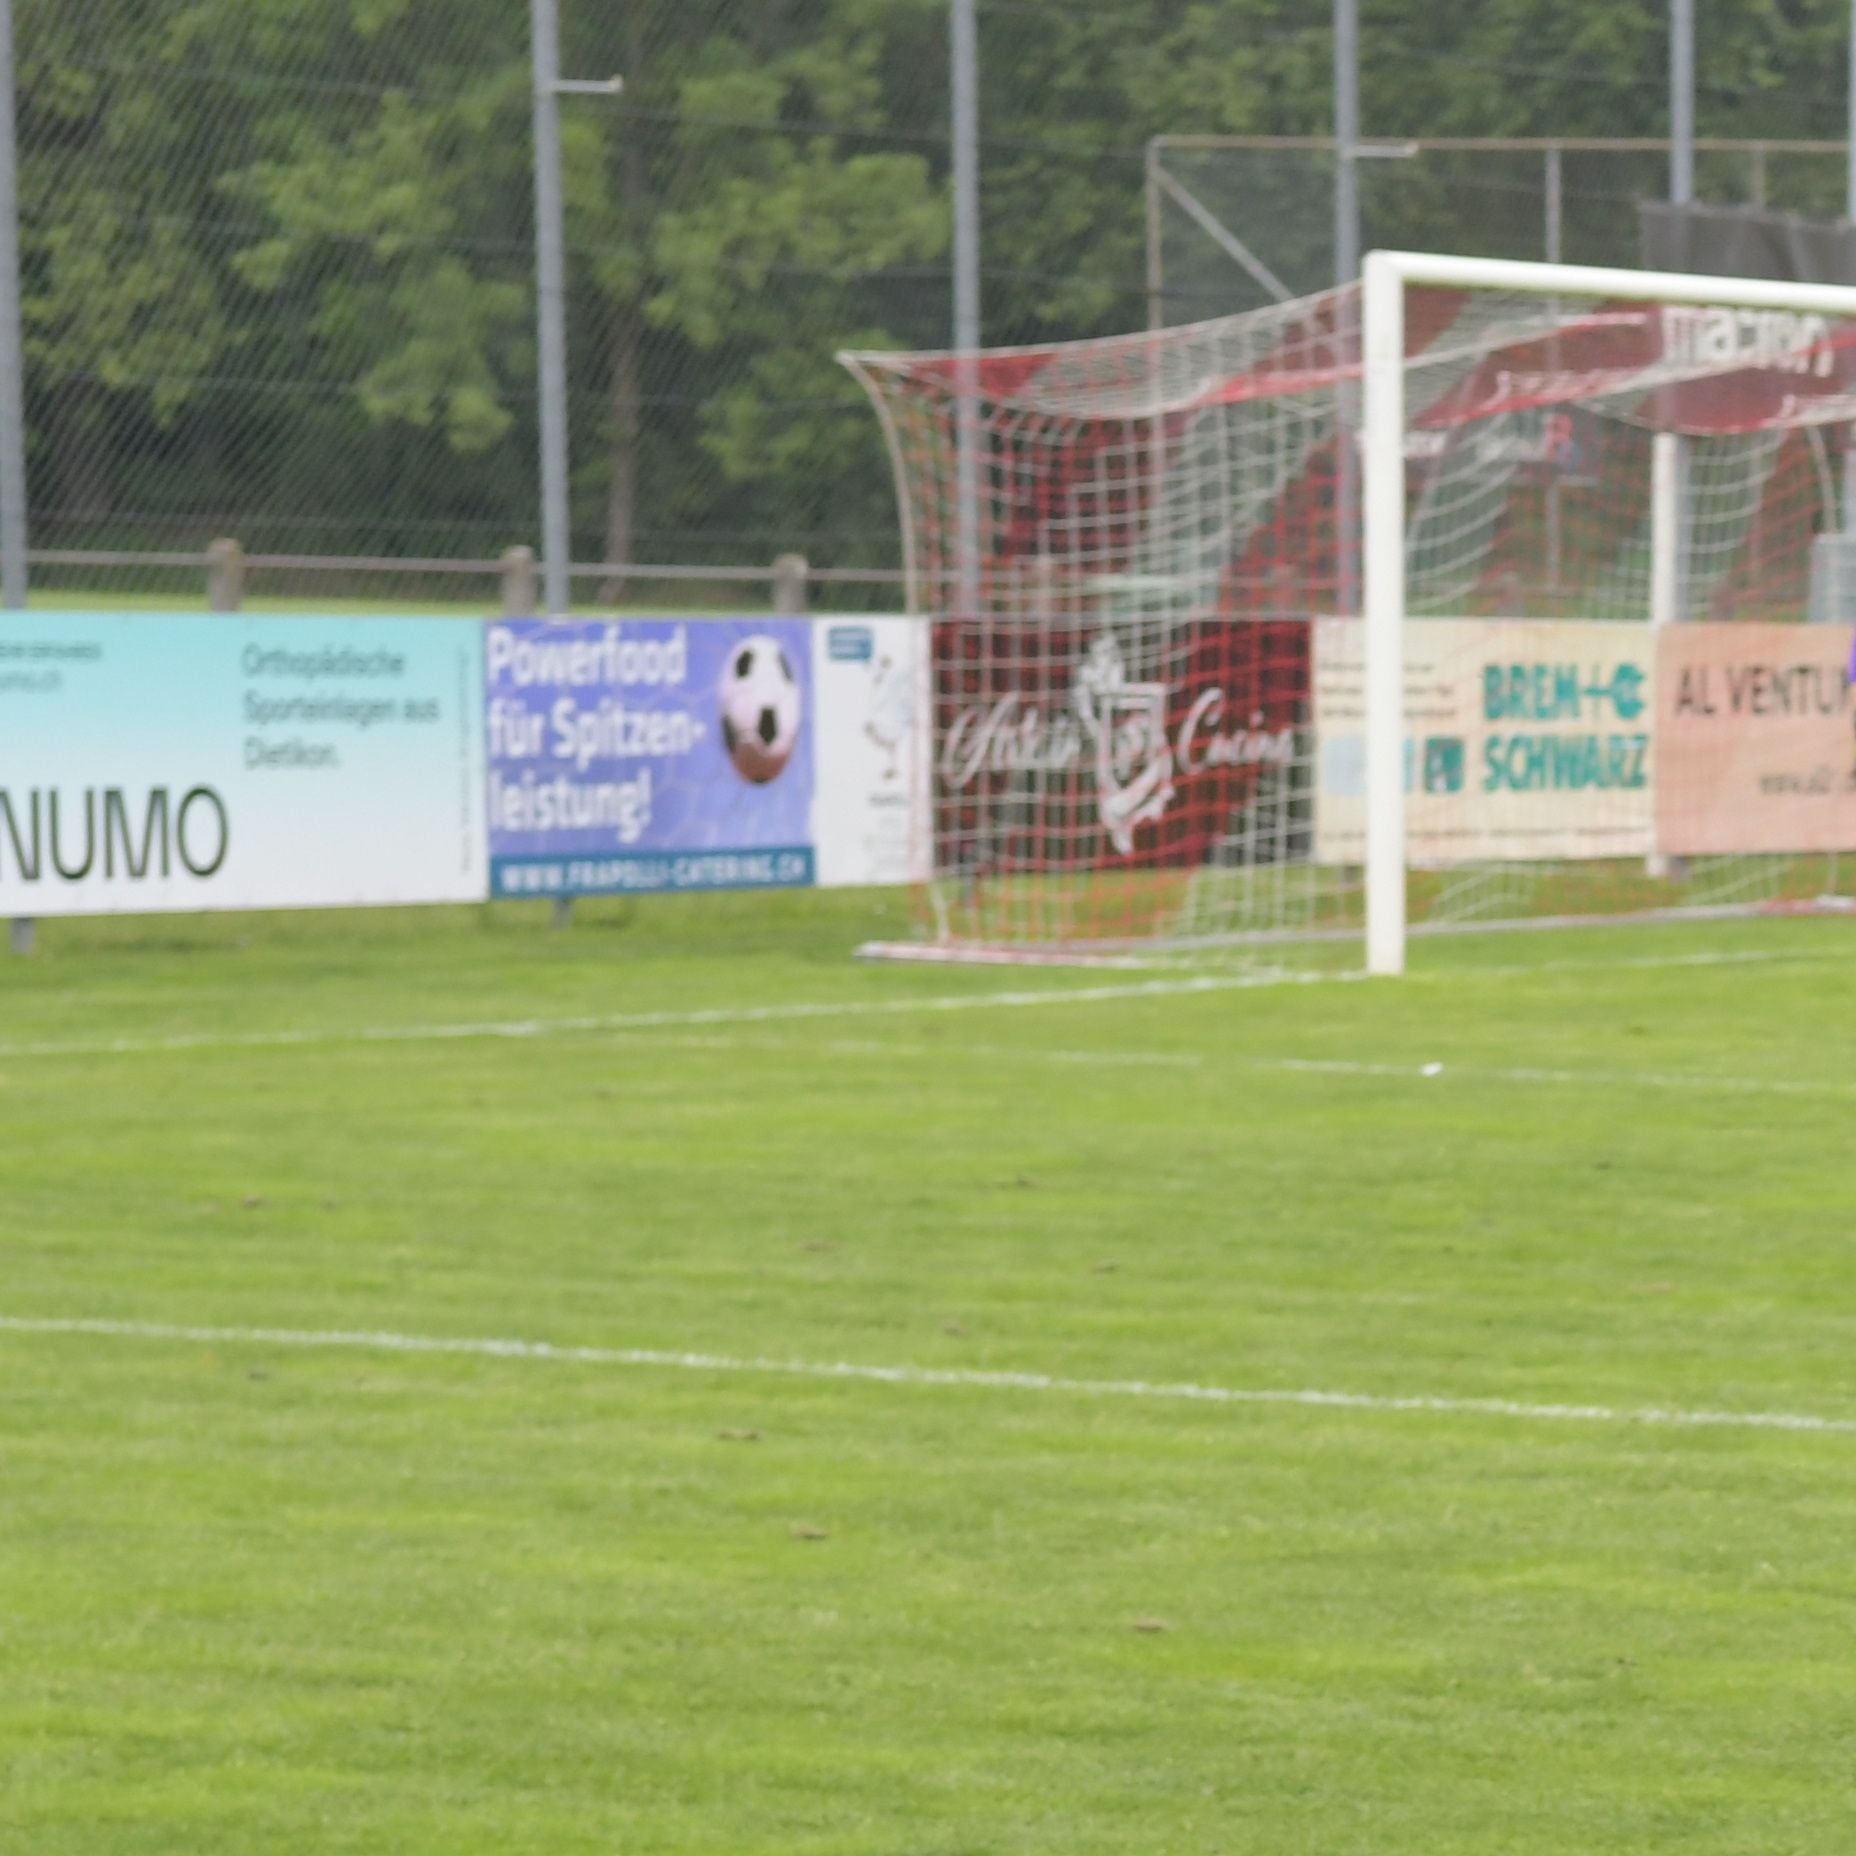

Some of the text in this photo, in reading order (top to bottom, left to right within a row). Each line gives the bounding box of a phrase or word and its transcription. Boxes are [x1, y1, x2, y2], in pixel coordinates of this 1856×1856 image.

[487, 625, 688, 686] Powerfood
[244, 691, 439, 730] Sporteinlagen aus
[487, 697, 708, 773] für Spitzen-
[1482, 734, 1648, 793] SCHWARZ
[487, 768, 653, 844] leistung!
